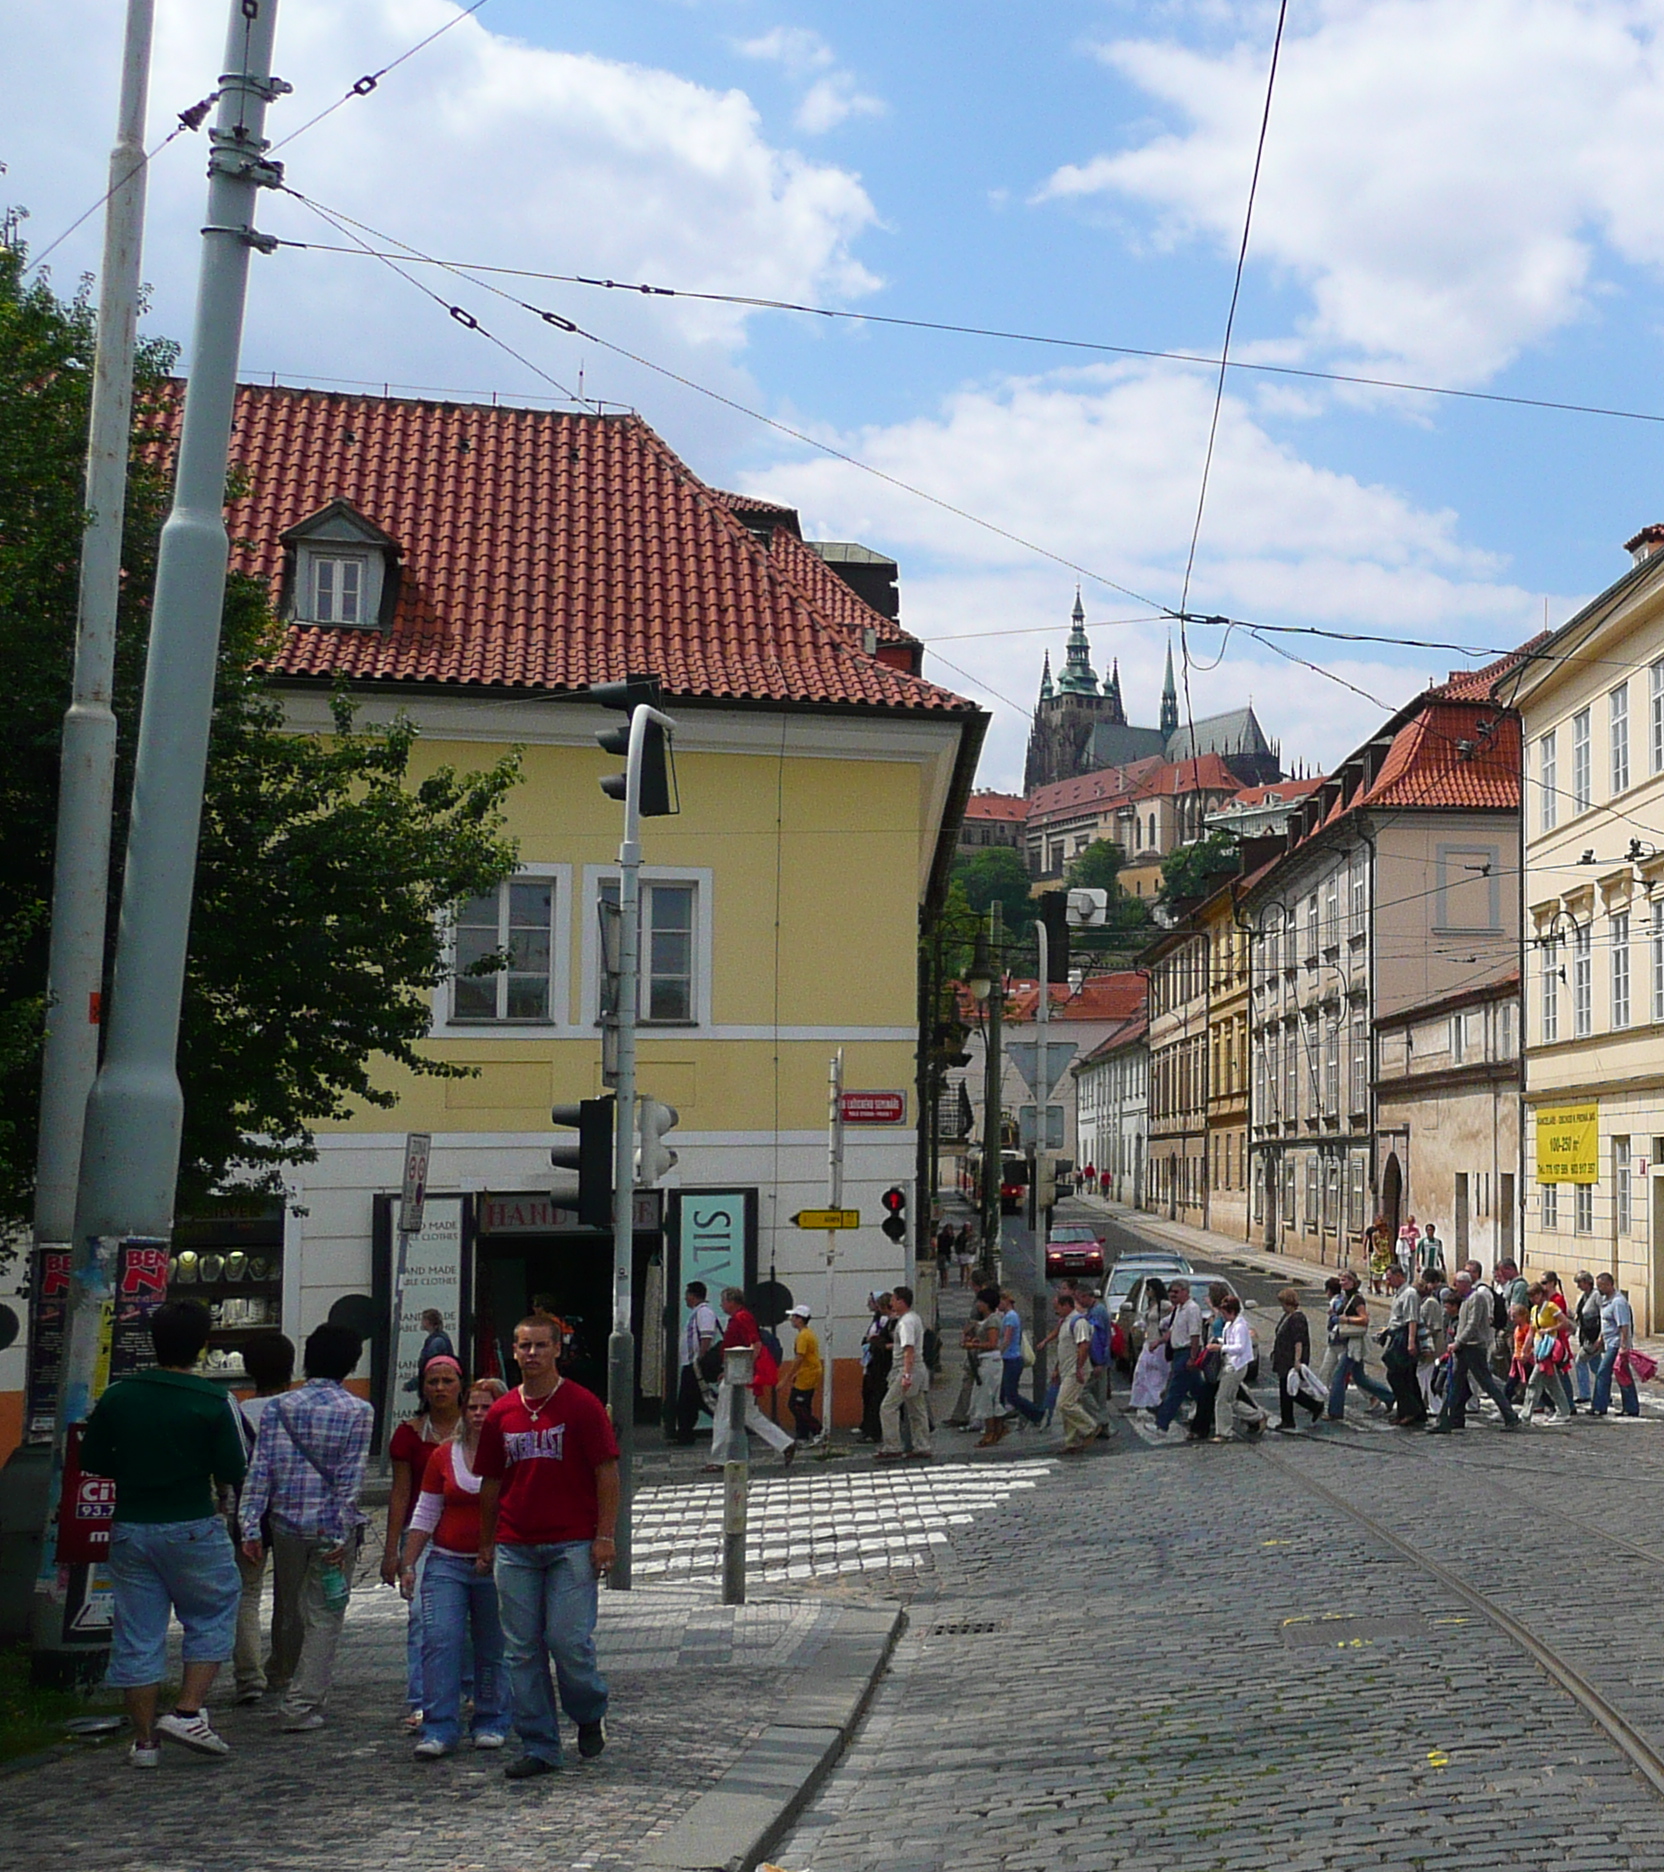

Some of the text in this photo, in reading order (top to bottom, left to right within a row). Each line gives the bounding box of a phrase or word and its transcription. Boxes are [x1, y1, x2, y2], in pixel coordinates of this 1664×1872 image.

[429, 1221, 458, 1231] MADE
[693, 1210, 732, 1289] SILV
[127, 1249, 169, 1269] BEN
[404, 1265, 457, 1275] AND MADE
[393, 1409, 417, 1418] HAN
[503, 1423, 565, 1468] EVERLAST
